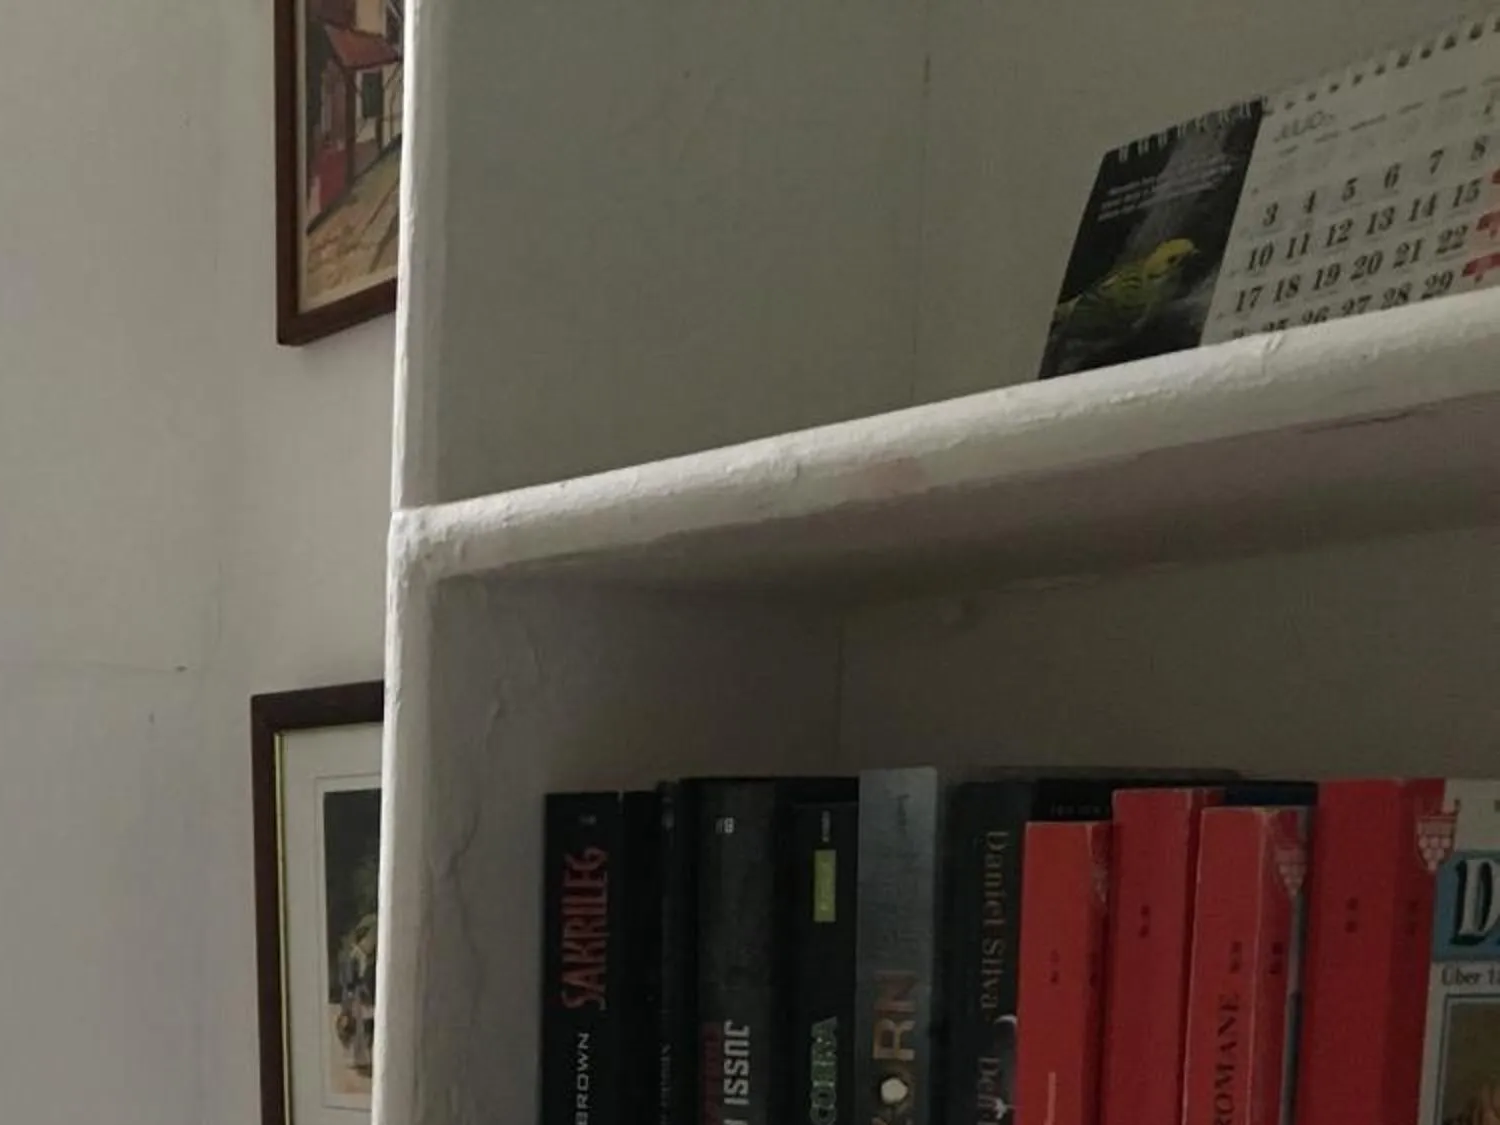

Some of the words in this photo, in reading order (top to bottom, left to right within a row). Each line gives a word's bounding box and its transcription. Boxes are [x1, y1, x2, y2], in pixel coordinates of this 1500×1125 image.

[1247, 244, 1274, 272] 10
[1285, 232, 1312, 261] 11
[1325, 219, 1355, 248] 12
[1366, 206, 1396, 236] 13
[1407, 193, 1437, 223] 14
[1452, 178, 1481, 208] 15
[1262, 203, 1278, 228] 3
[1342, 177, 1359, 202] 5
[1383, 164, 1401, 189] 6
[1428, 149, 1445, 175] 7
[1234, 286, 1264, 313] 17
[1272, 273, 1302, 303] 18
[1312, 261, 1342, 290] 19
[1350, 251, 1382, 282] 20
[1393, 237, 1424, 268] 21
[1436, 225, 1469, 255] 22
[1421, 270, 1455, 299] 29
[982, 830, 1012, 938] Daniel
[562, 846, 609, 1010] SAKRILEG
[980, 943, 1006, 1013] Silva
[723, 1020, 751, 1105] JUSSI
